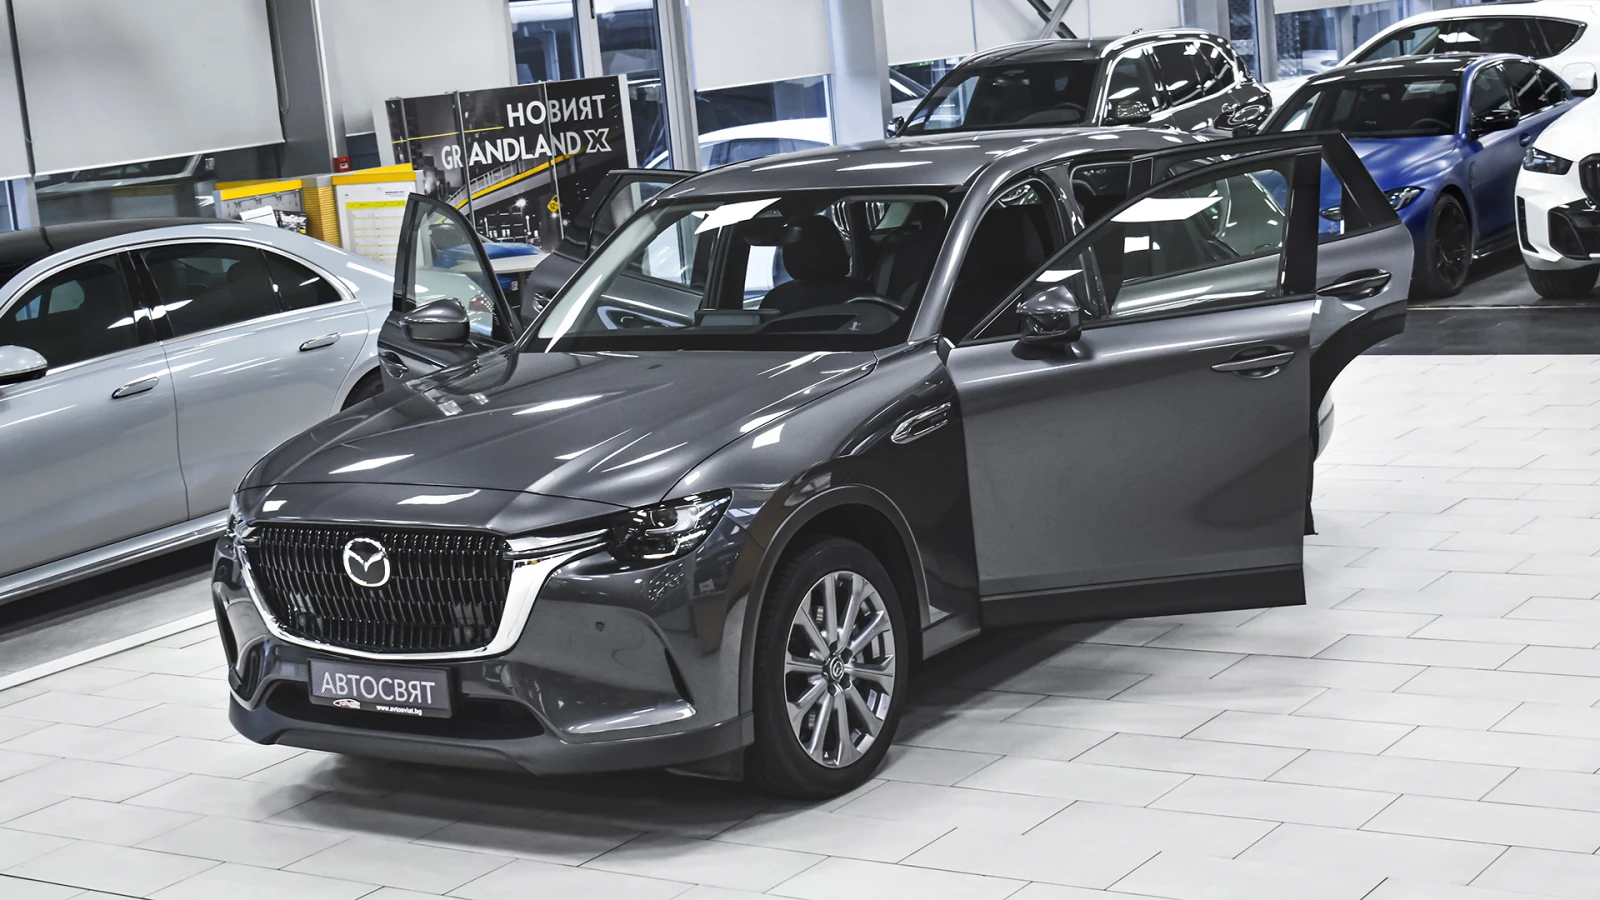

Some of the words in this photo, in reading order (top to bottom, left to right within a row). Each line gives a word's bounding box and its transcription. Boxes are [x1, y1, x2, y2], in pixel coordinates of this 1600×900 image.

[506, 95, 606, 128] НОВИЯТ
[441, 131, 582, 170] GRANDLAND
[583, 128, 612, 154] X
[321, 671, 435, 704] АВТОСВЯТ
